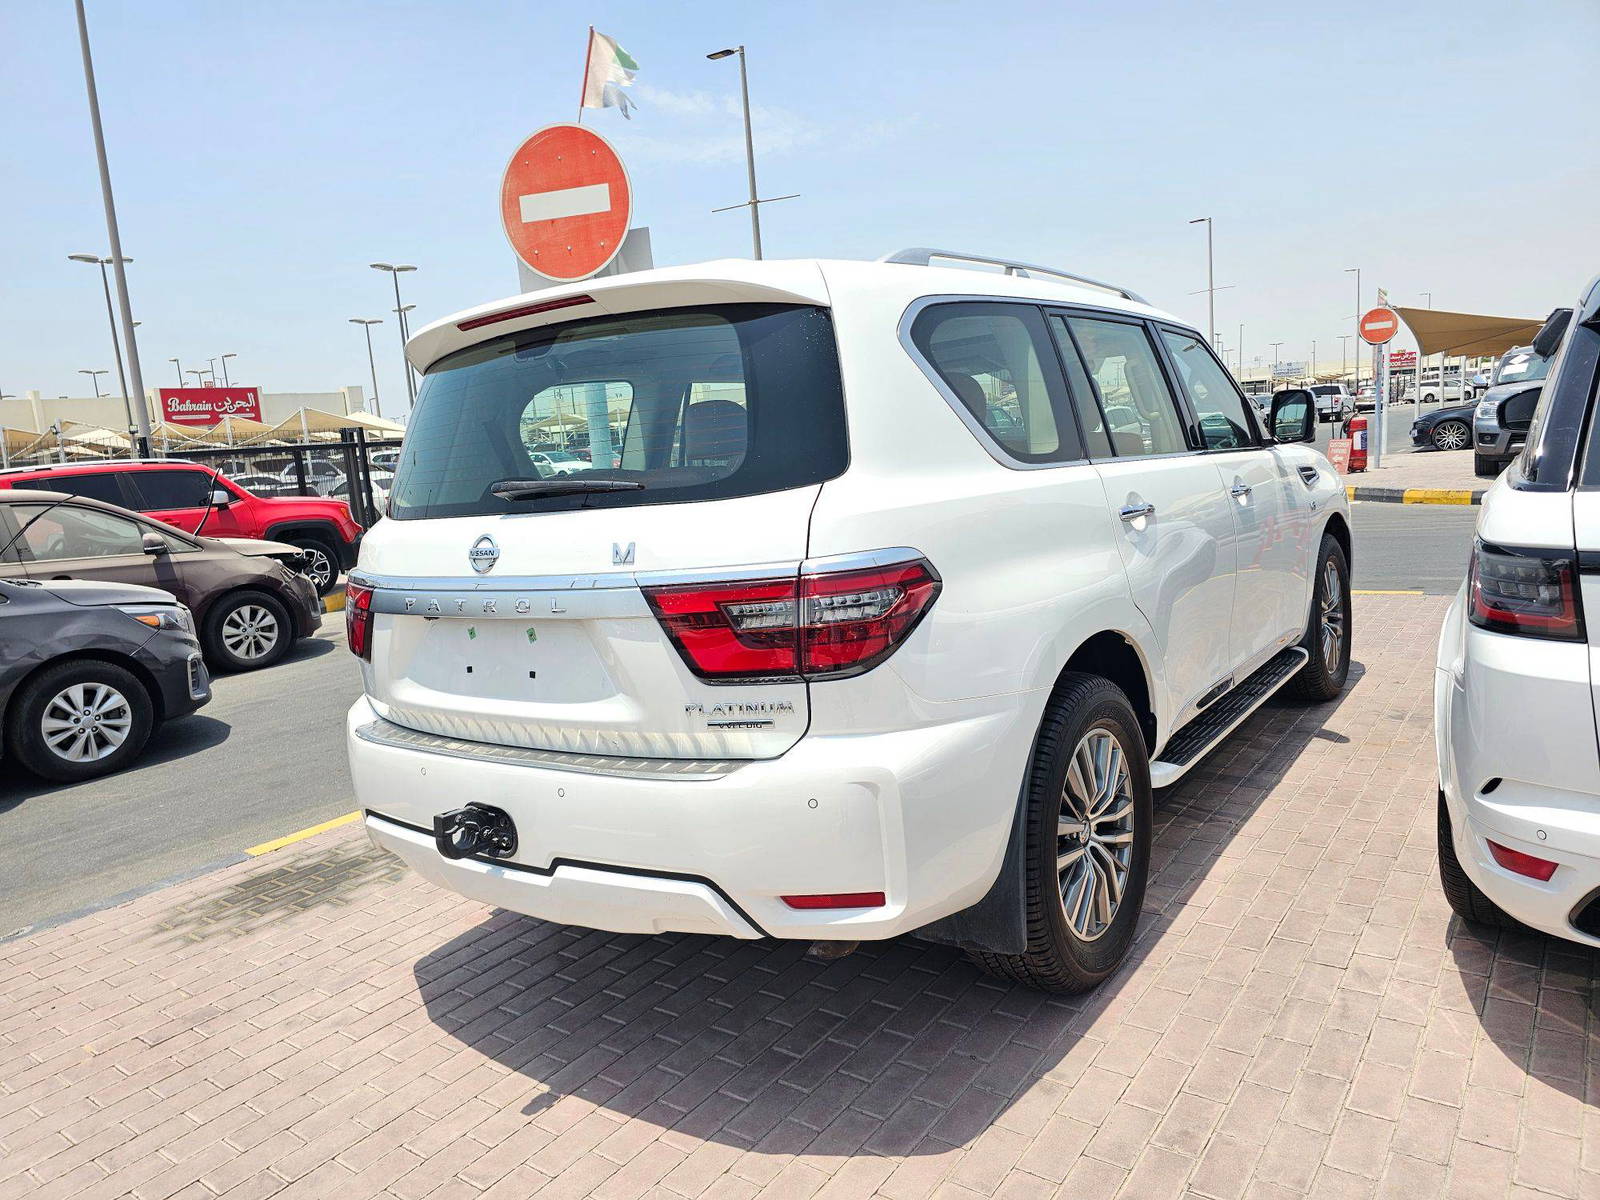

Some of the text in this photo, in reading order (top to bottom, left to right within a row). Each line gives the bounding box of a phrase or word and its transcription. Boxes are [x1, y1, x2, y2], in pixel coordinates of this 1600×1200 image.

[167, 397, 213, 412] Bahrain
[213, 392, 255, 413] البحرين
[469, 549, 496, 557] NISSAN
[405, 597, 567, 614] PATROL
[684, 701, 795, 715] PLATINUM
